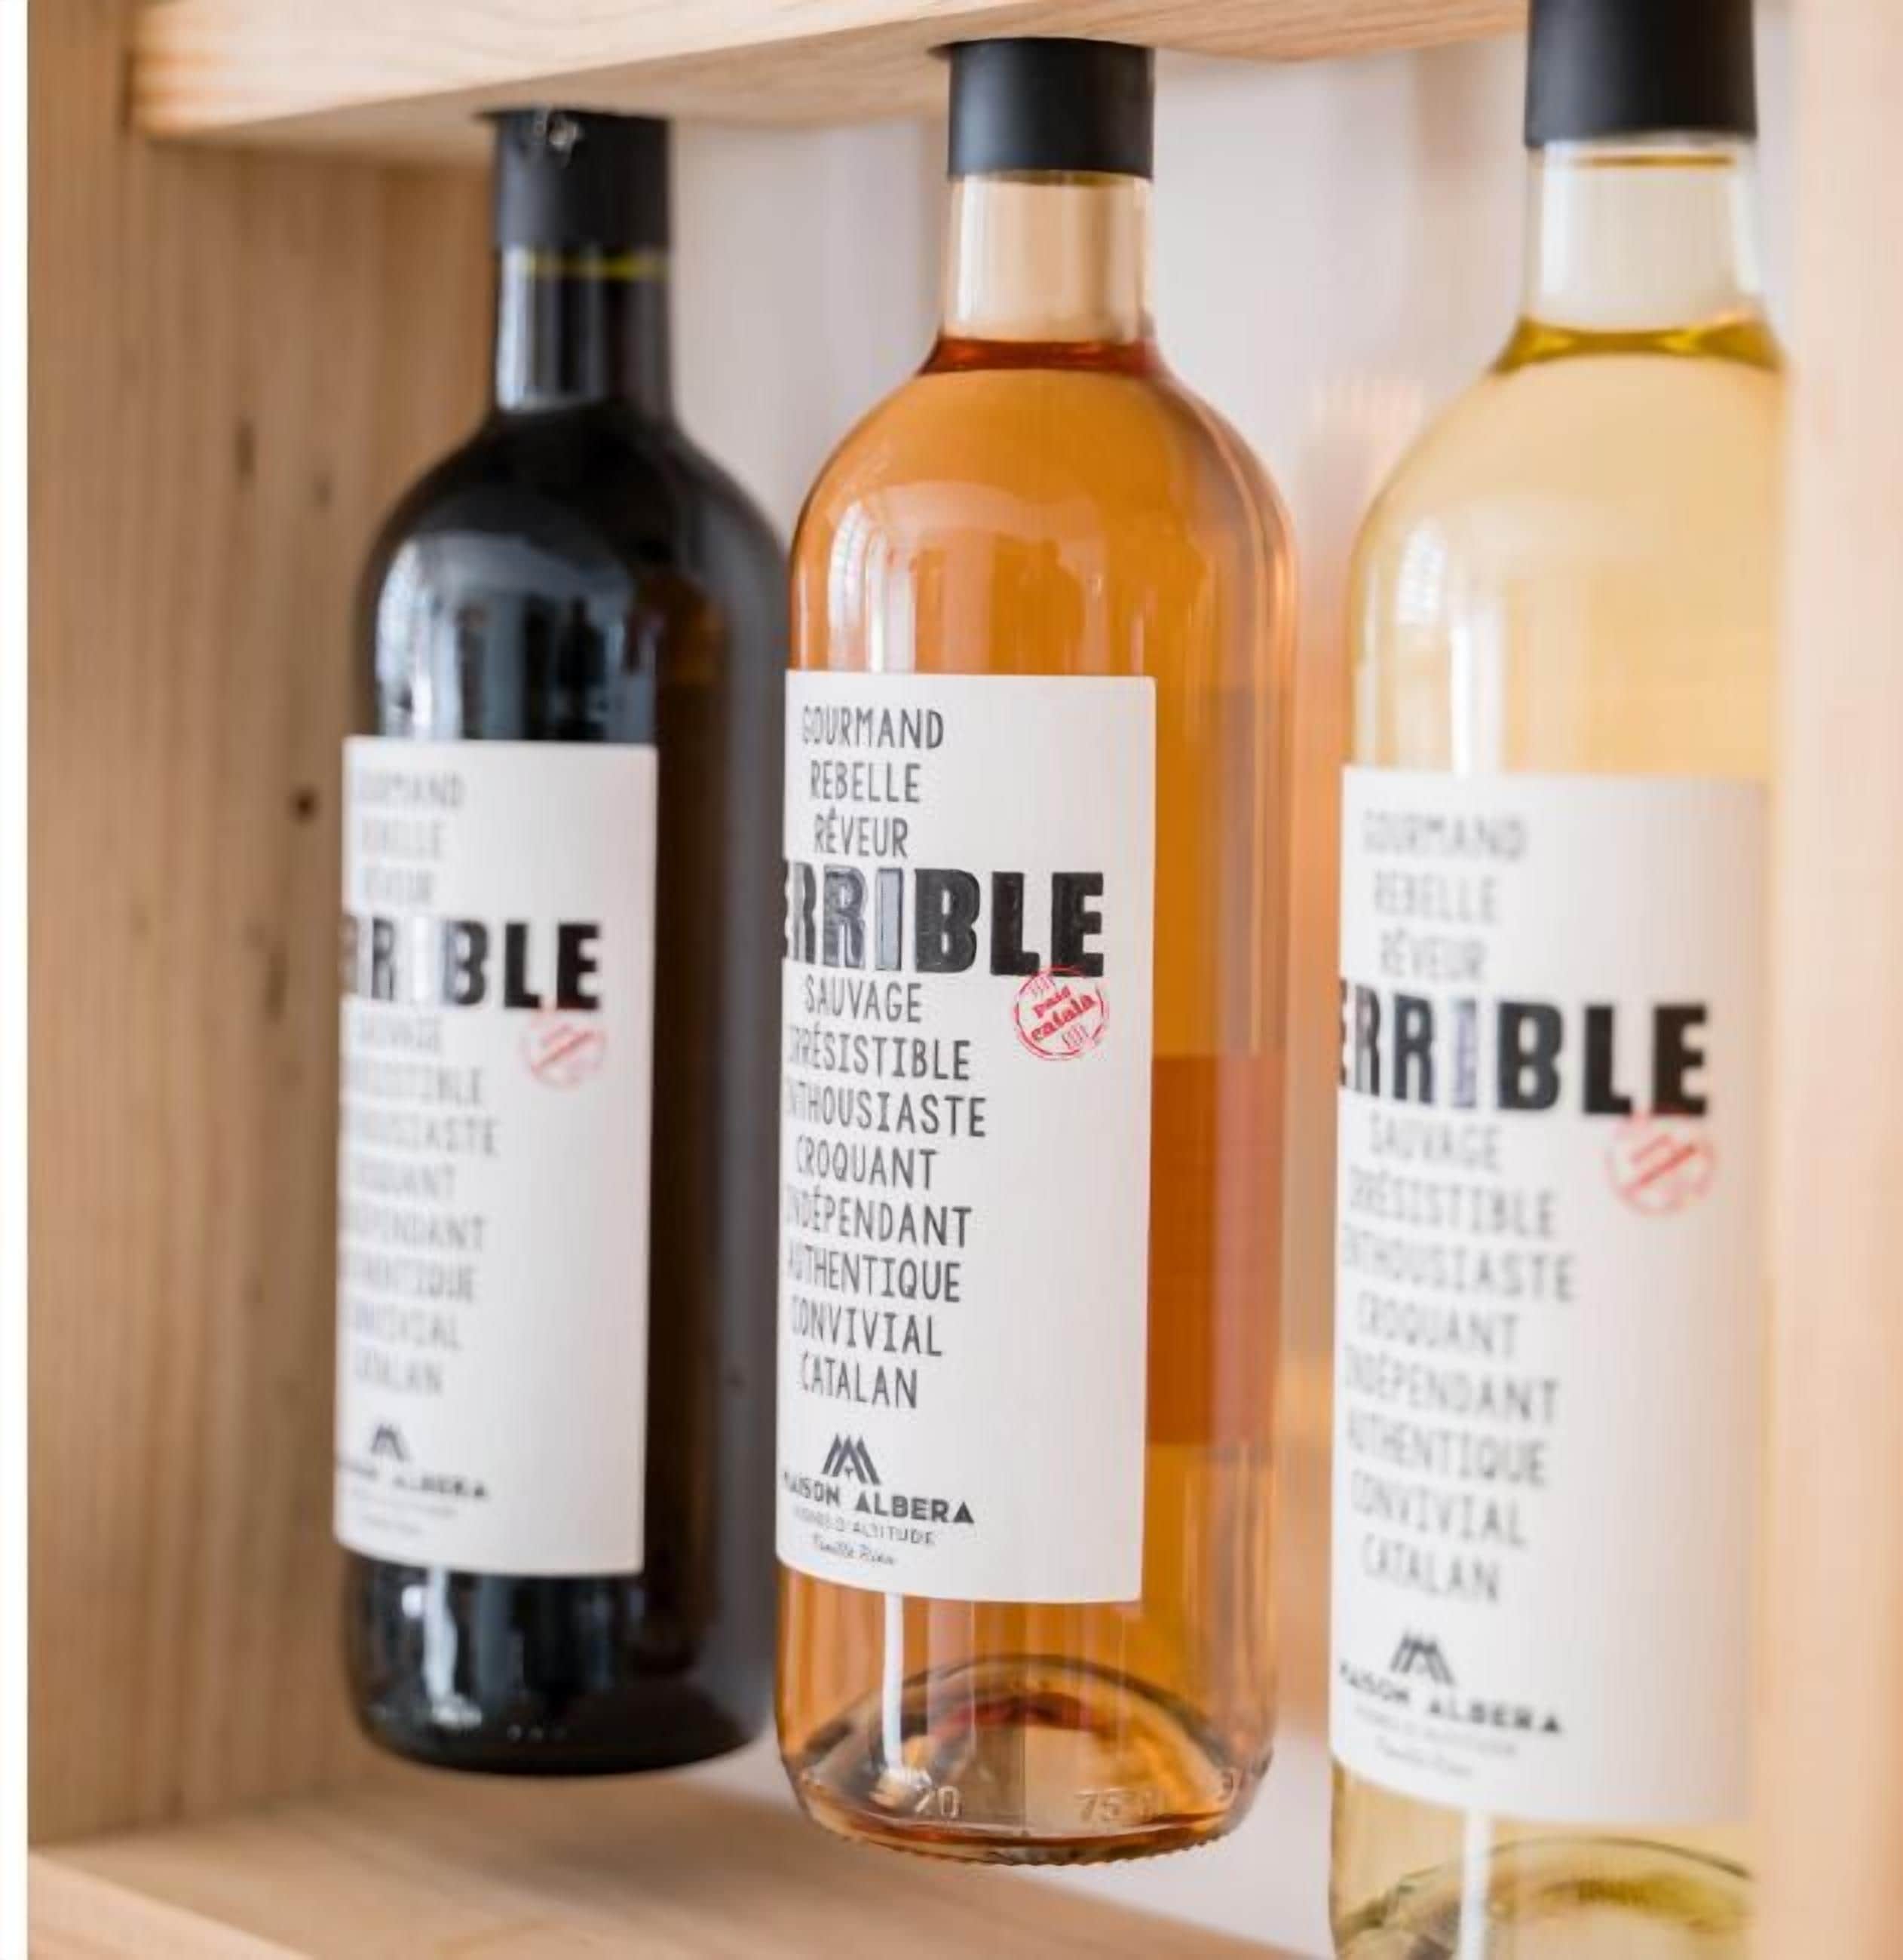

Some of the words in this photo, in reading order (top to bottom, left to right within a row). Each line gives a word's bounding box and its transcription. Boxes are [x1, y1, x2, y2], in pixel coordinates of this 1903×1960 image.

[810, 760, 921, 803] REBELLE
[785, 862, 1105, 977] RRIBLE
[804, 972, 922, 1023] SAUVAGE
[800, 1350, 918, 1409] CATALAN
[856, 1491, 975, 1524] ALBERA
